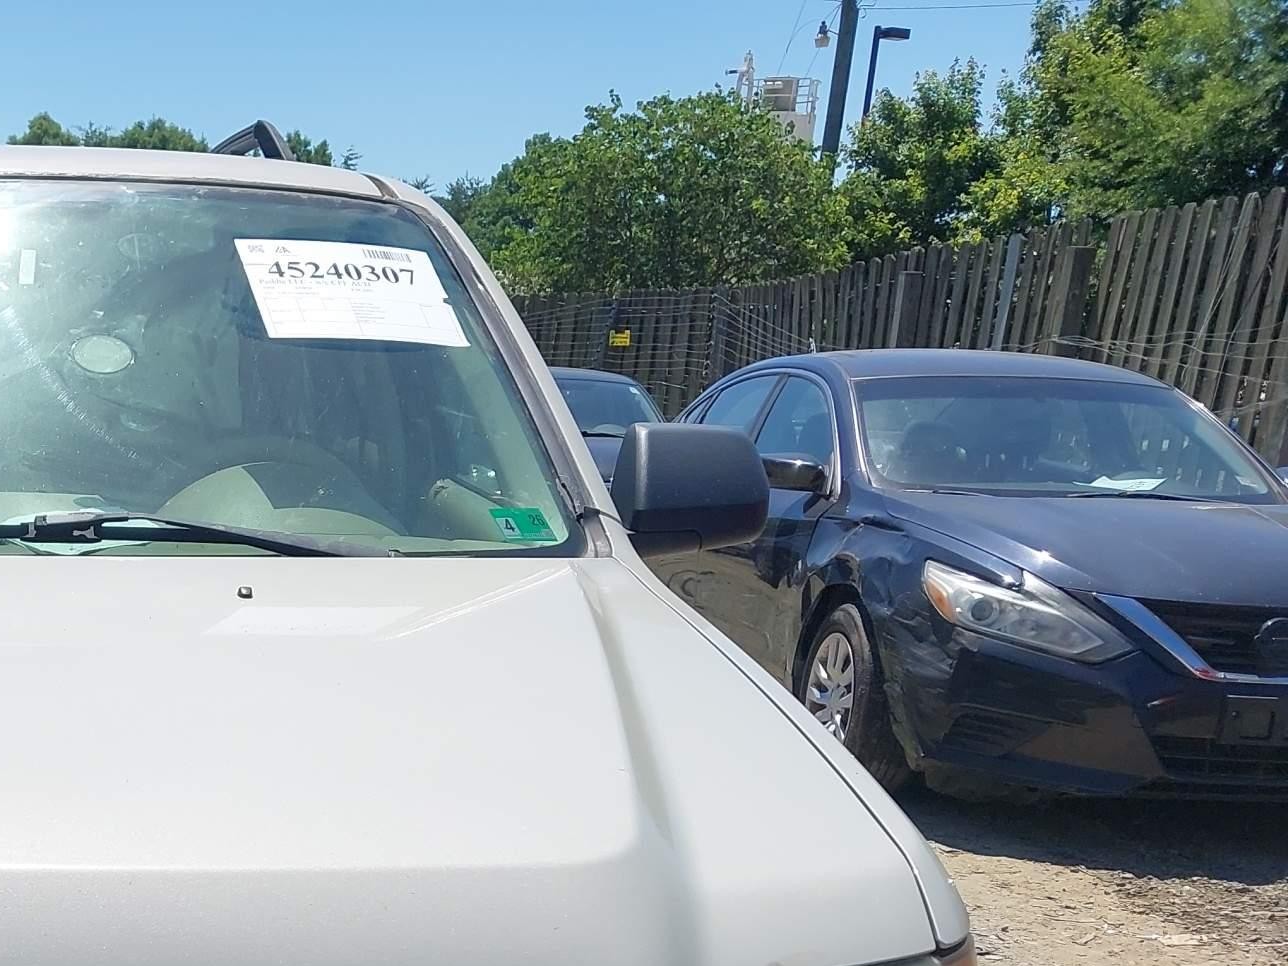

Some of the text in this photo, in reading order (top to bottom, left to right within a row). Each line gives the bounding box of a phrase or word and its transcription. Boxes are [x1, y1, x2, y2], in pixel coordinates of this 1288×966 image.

[268, 260, 415, 285] 45240307
[504, 514, 545, 532] 4 26
